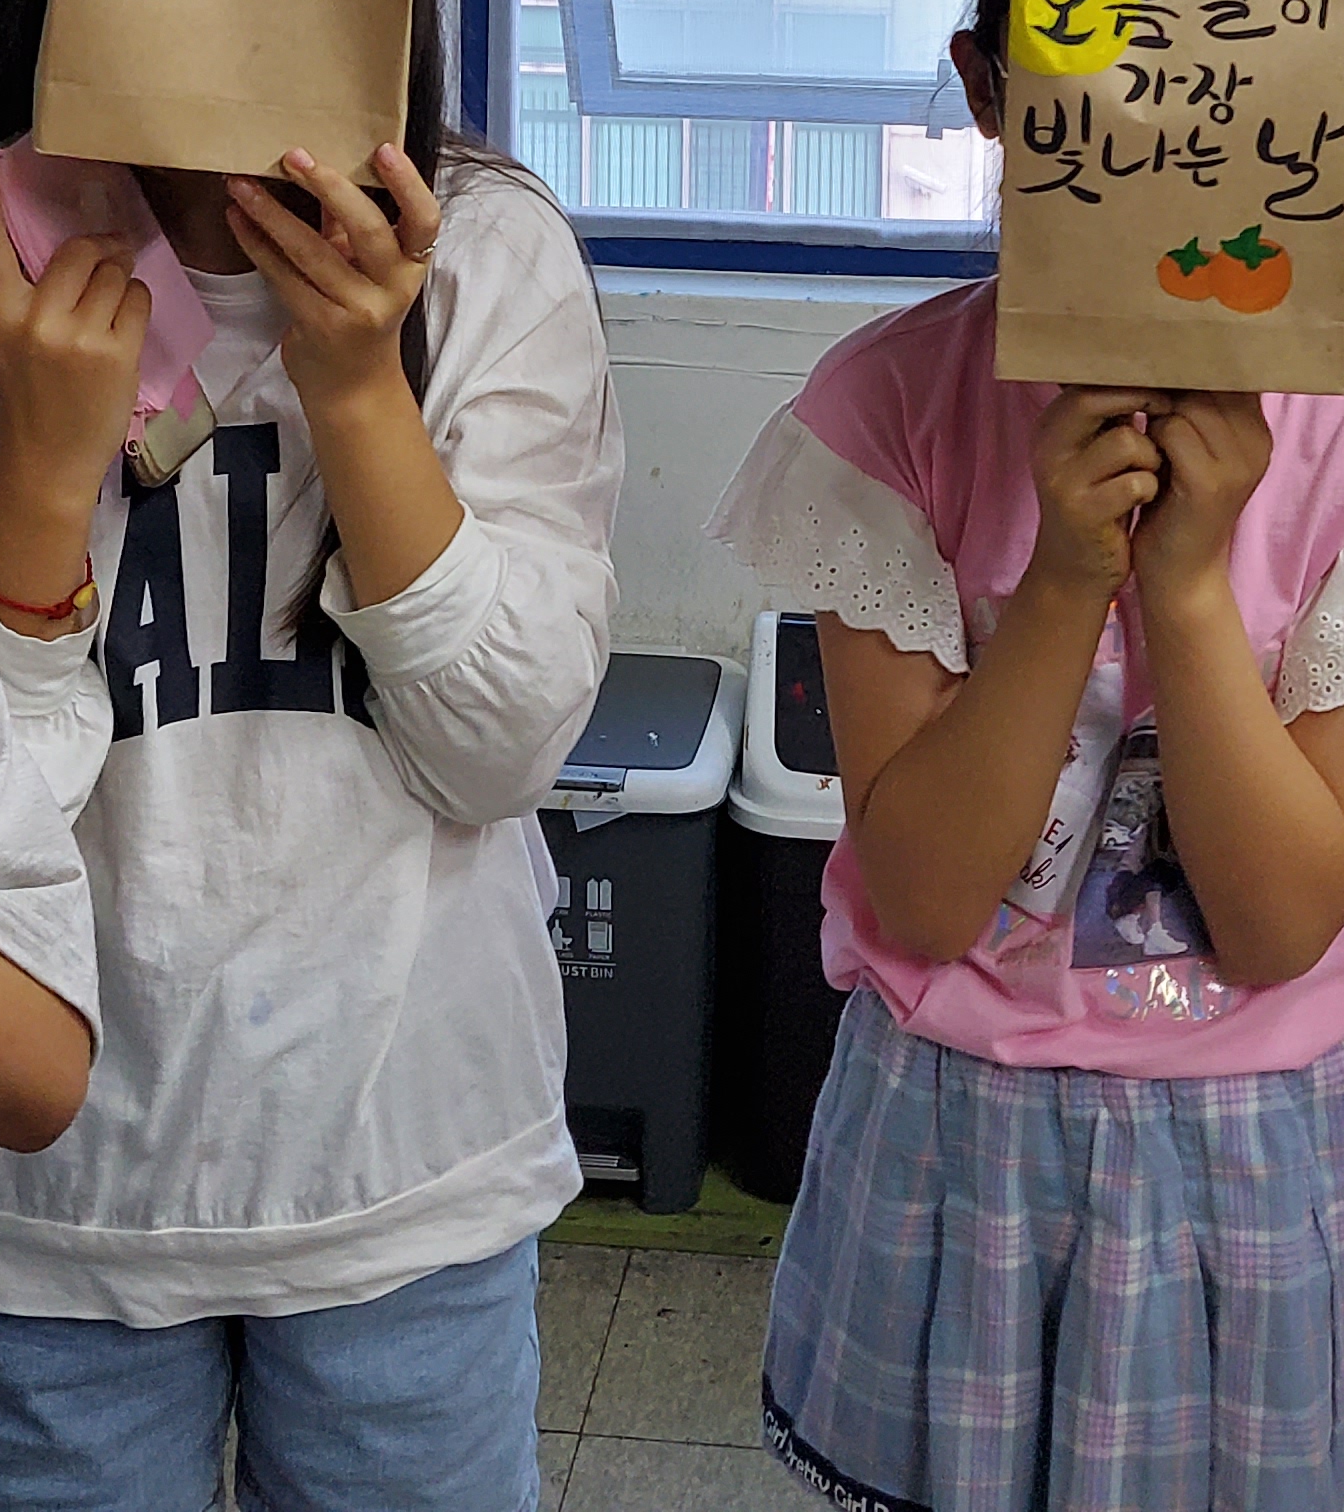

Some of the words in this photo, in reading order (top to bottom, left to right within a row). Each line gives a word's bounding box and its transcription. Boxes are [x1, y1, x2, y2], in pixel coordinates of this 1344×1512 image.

[1117, 62, 1255, 125] 가장
[1016, 93, 1228, 203] 빛나는
[561, 965, 588, 977] UST
[590, 967, 614, 978] BIN
